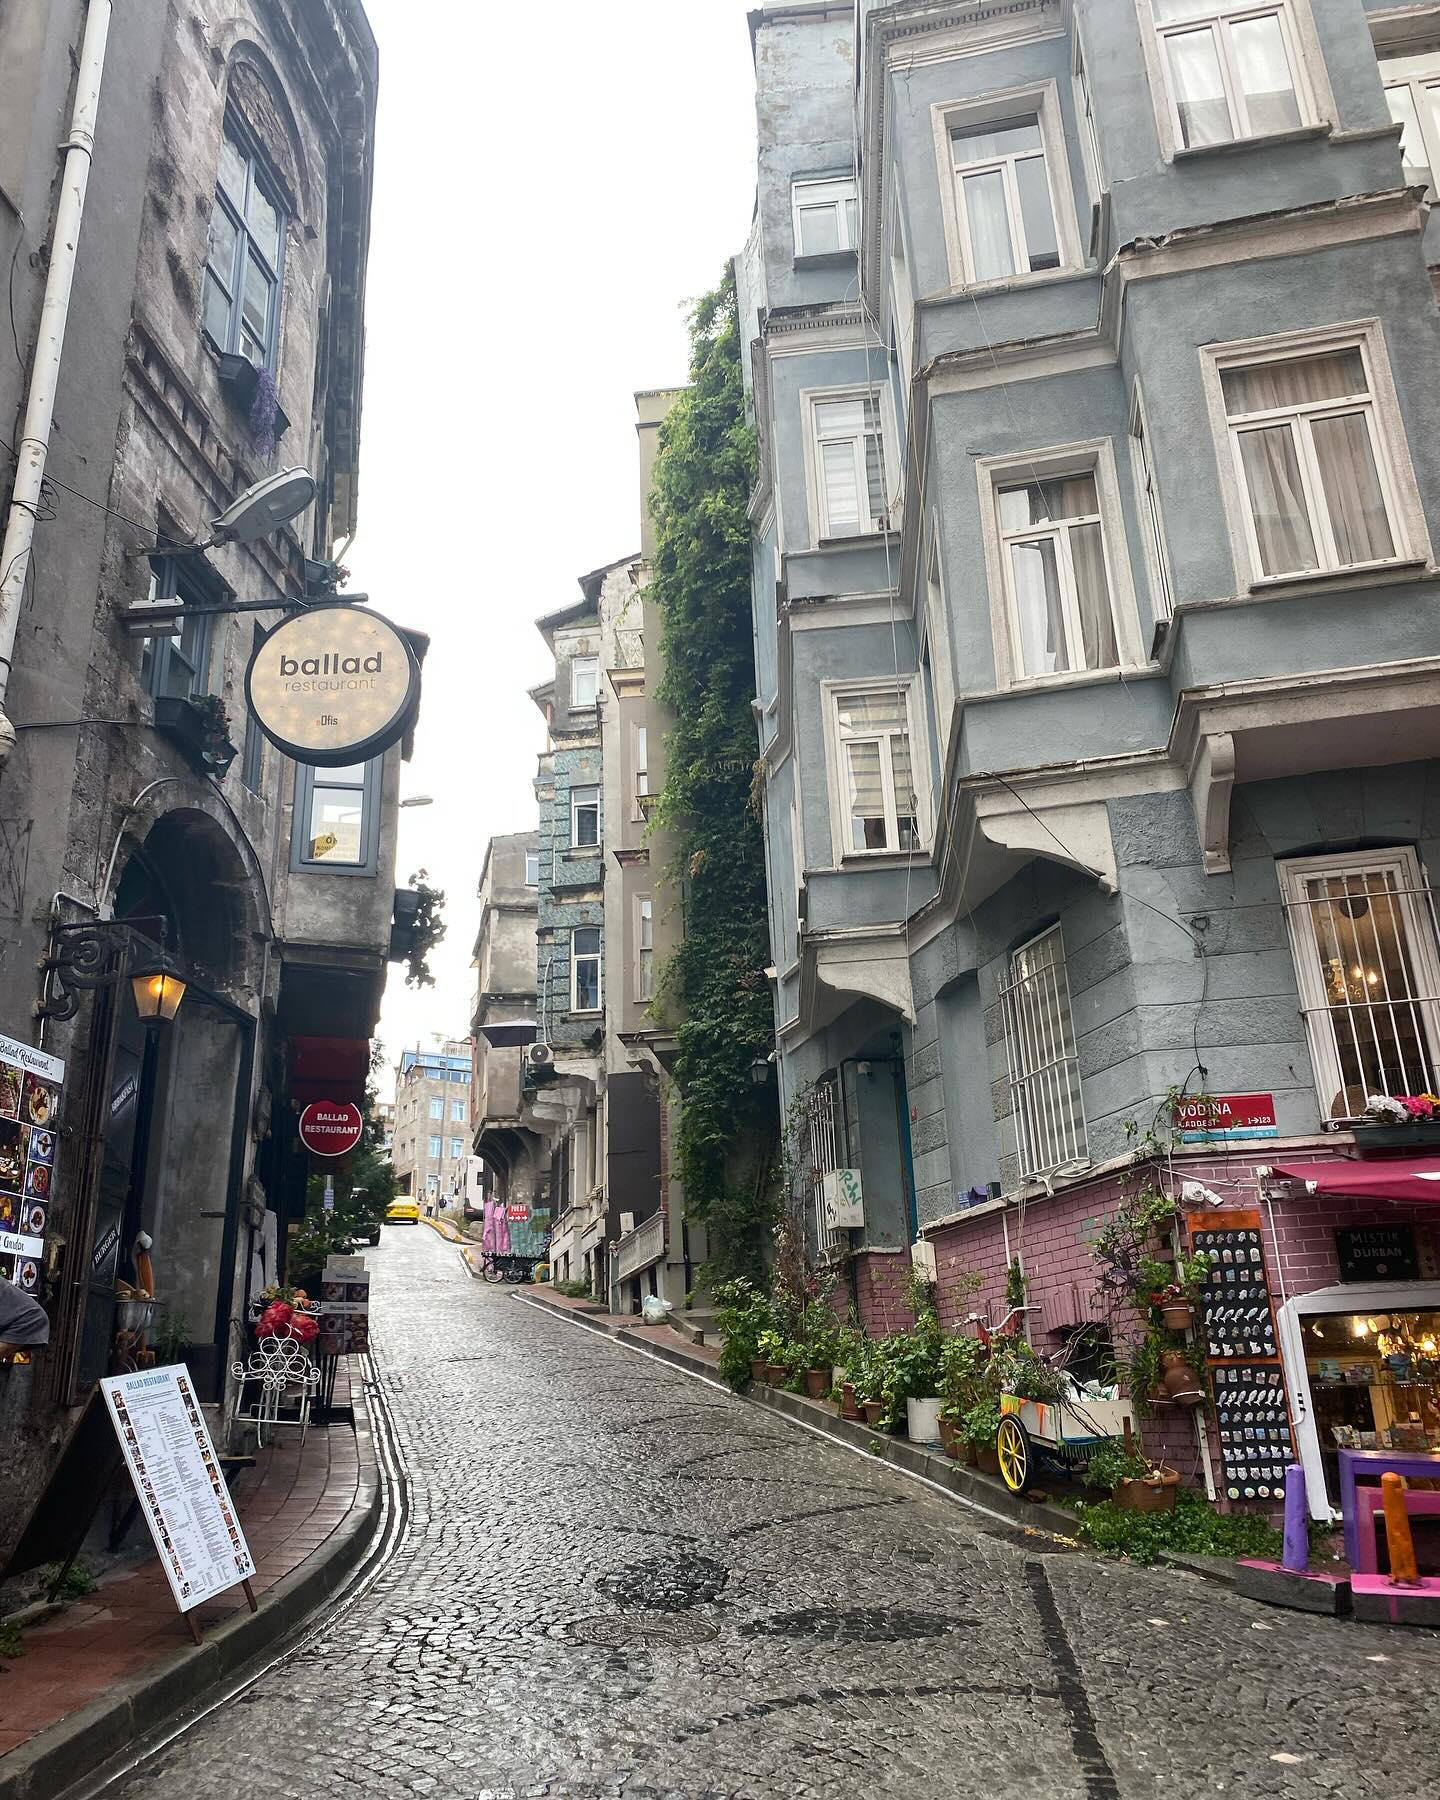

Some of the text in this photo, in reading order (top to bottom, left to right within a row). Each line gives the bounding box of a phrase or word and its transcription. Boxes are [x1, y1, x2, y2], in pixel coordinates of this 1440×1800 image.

[280, 652, 382, 676] ballad
[285, 677, 375, 692] restaurant
[317, 1113, 349, 1121] BALLAD
[304, 1125, 359, 1134] RESTAURANT
[95, 1230, 116, 1264] BURGER
[125, 1373, 171, 1390] BALLAD RESTAURANT
